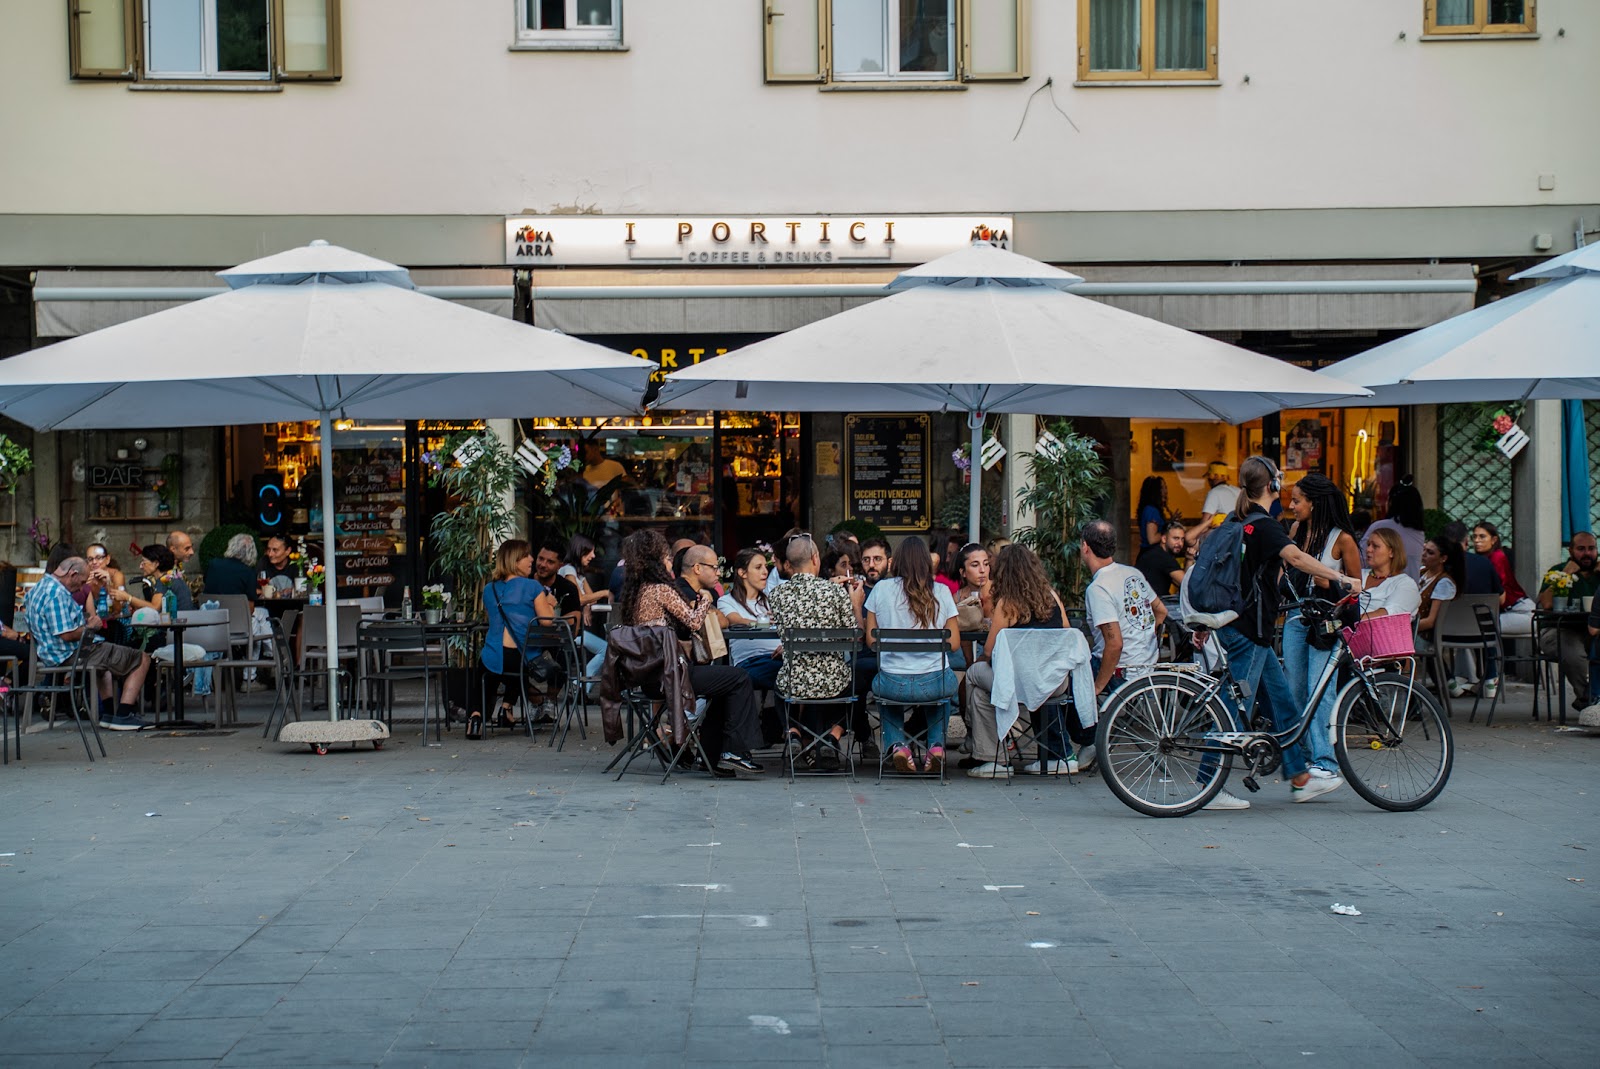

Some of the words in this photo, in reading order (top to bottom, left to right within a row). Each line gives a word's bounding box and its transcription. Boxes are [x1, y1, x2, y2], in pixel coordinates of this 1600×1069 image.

[515, 230, 554, 243] MOKA
[625, 222, 636, 243] I
[678, 222, 895, 243] PORTICI
[516, 244, 553, 256] ARRA
[688, 251, 749, 263] COFFEE
[757, 251, 767, 262] &
[775, 251, 832, 262] DRINKS
[93, 466, 142, 486] BAR
[345, 482, 390, 495] MARGARITA
[854, 489, 887, 499] CICCHETTI
[887, 489, 922, 499] VENEZIANI
[346, 575, 392, 586] Americano
